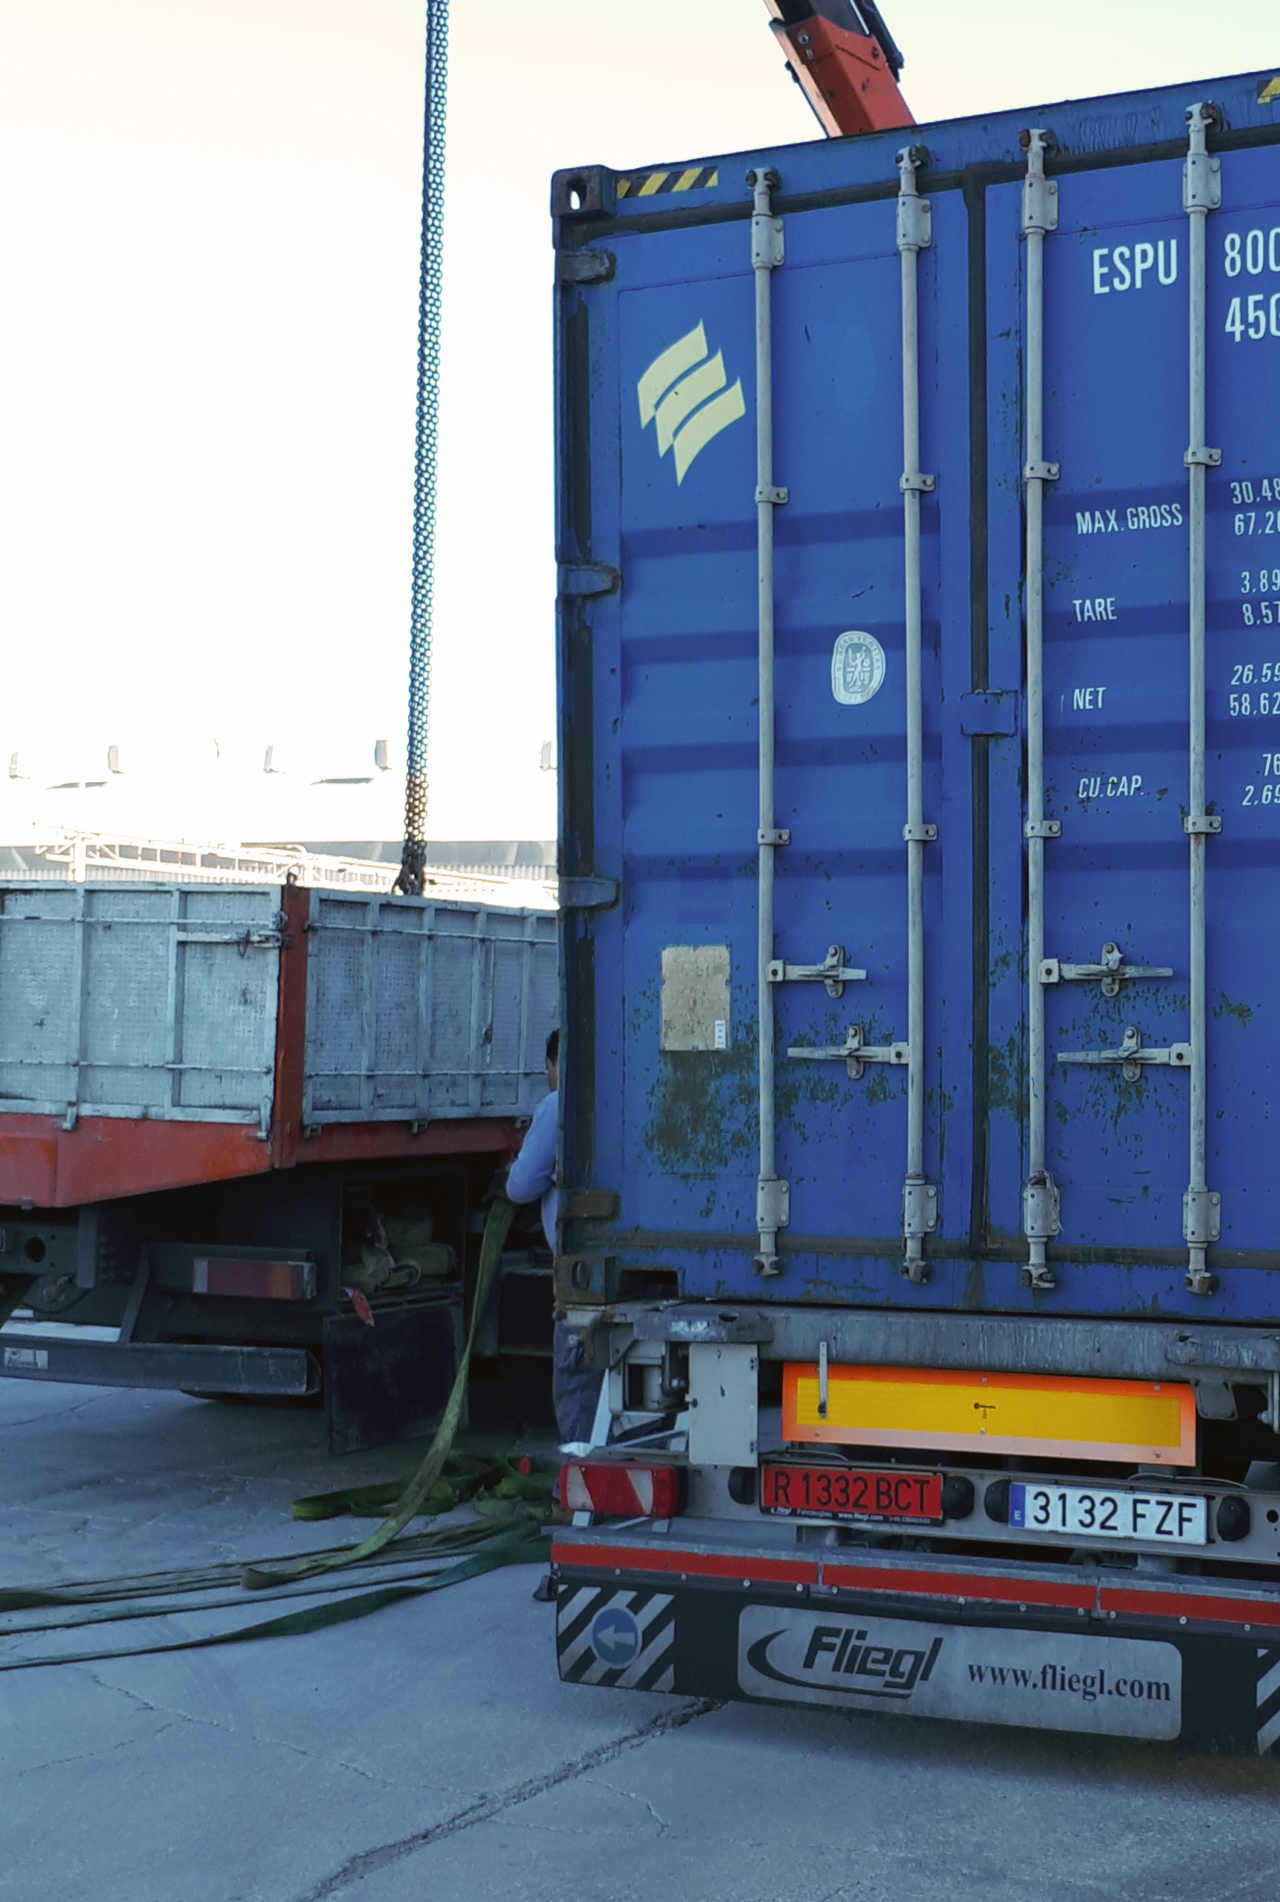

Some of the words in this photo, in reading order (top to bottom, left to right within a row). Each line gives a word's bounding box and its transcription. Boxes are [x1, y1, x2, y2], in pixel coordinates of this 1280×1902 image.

[1093, 239, 1177, 294] ESPU
[1073, 598, 1117, 622] TARE
[1073, 687, 1106, 710] NET
[774, 1471, 790, 1504] R
[802, 1474, 868, 1509] 1332
[876, 1477, 930, 1512] BCT
[1014, 1510, 1022, 1520] E
[1033, 1491, 1118, 1531] 3132
[1132, 1499, 1197, 1536] FZF
[803, 1625, 944, 1690] Fliegl
[968, 1663, 1170, 1701] www.fliegl.com
